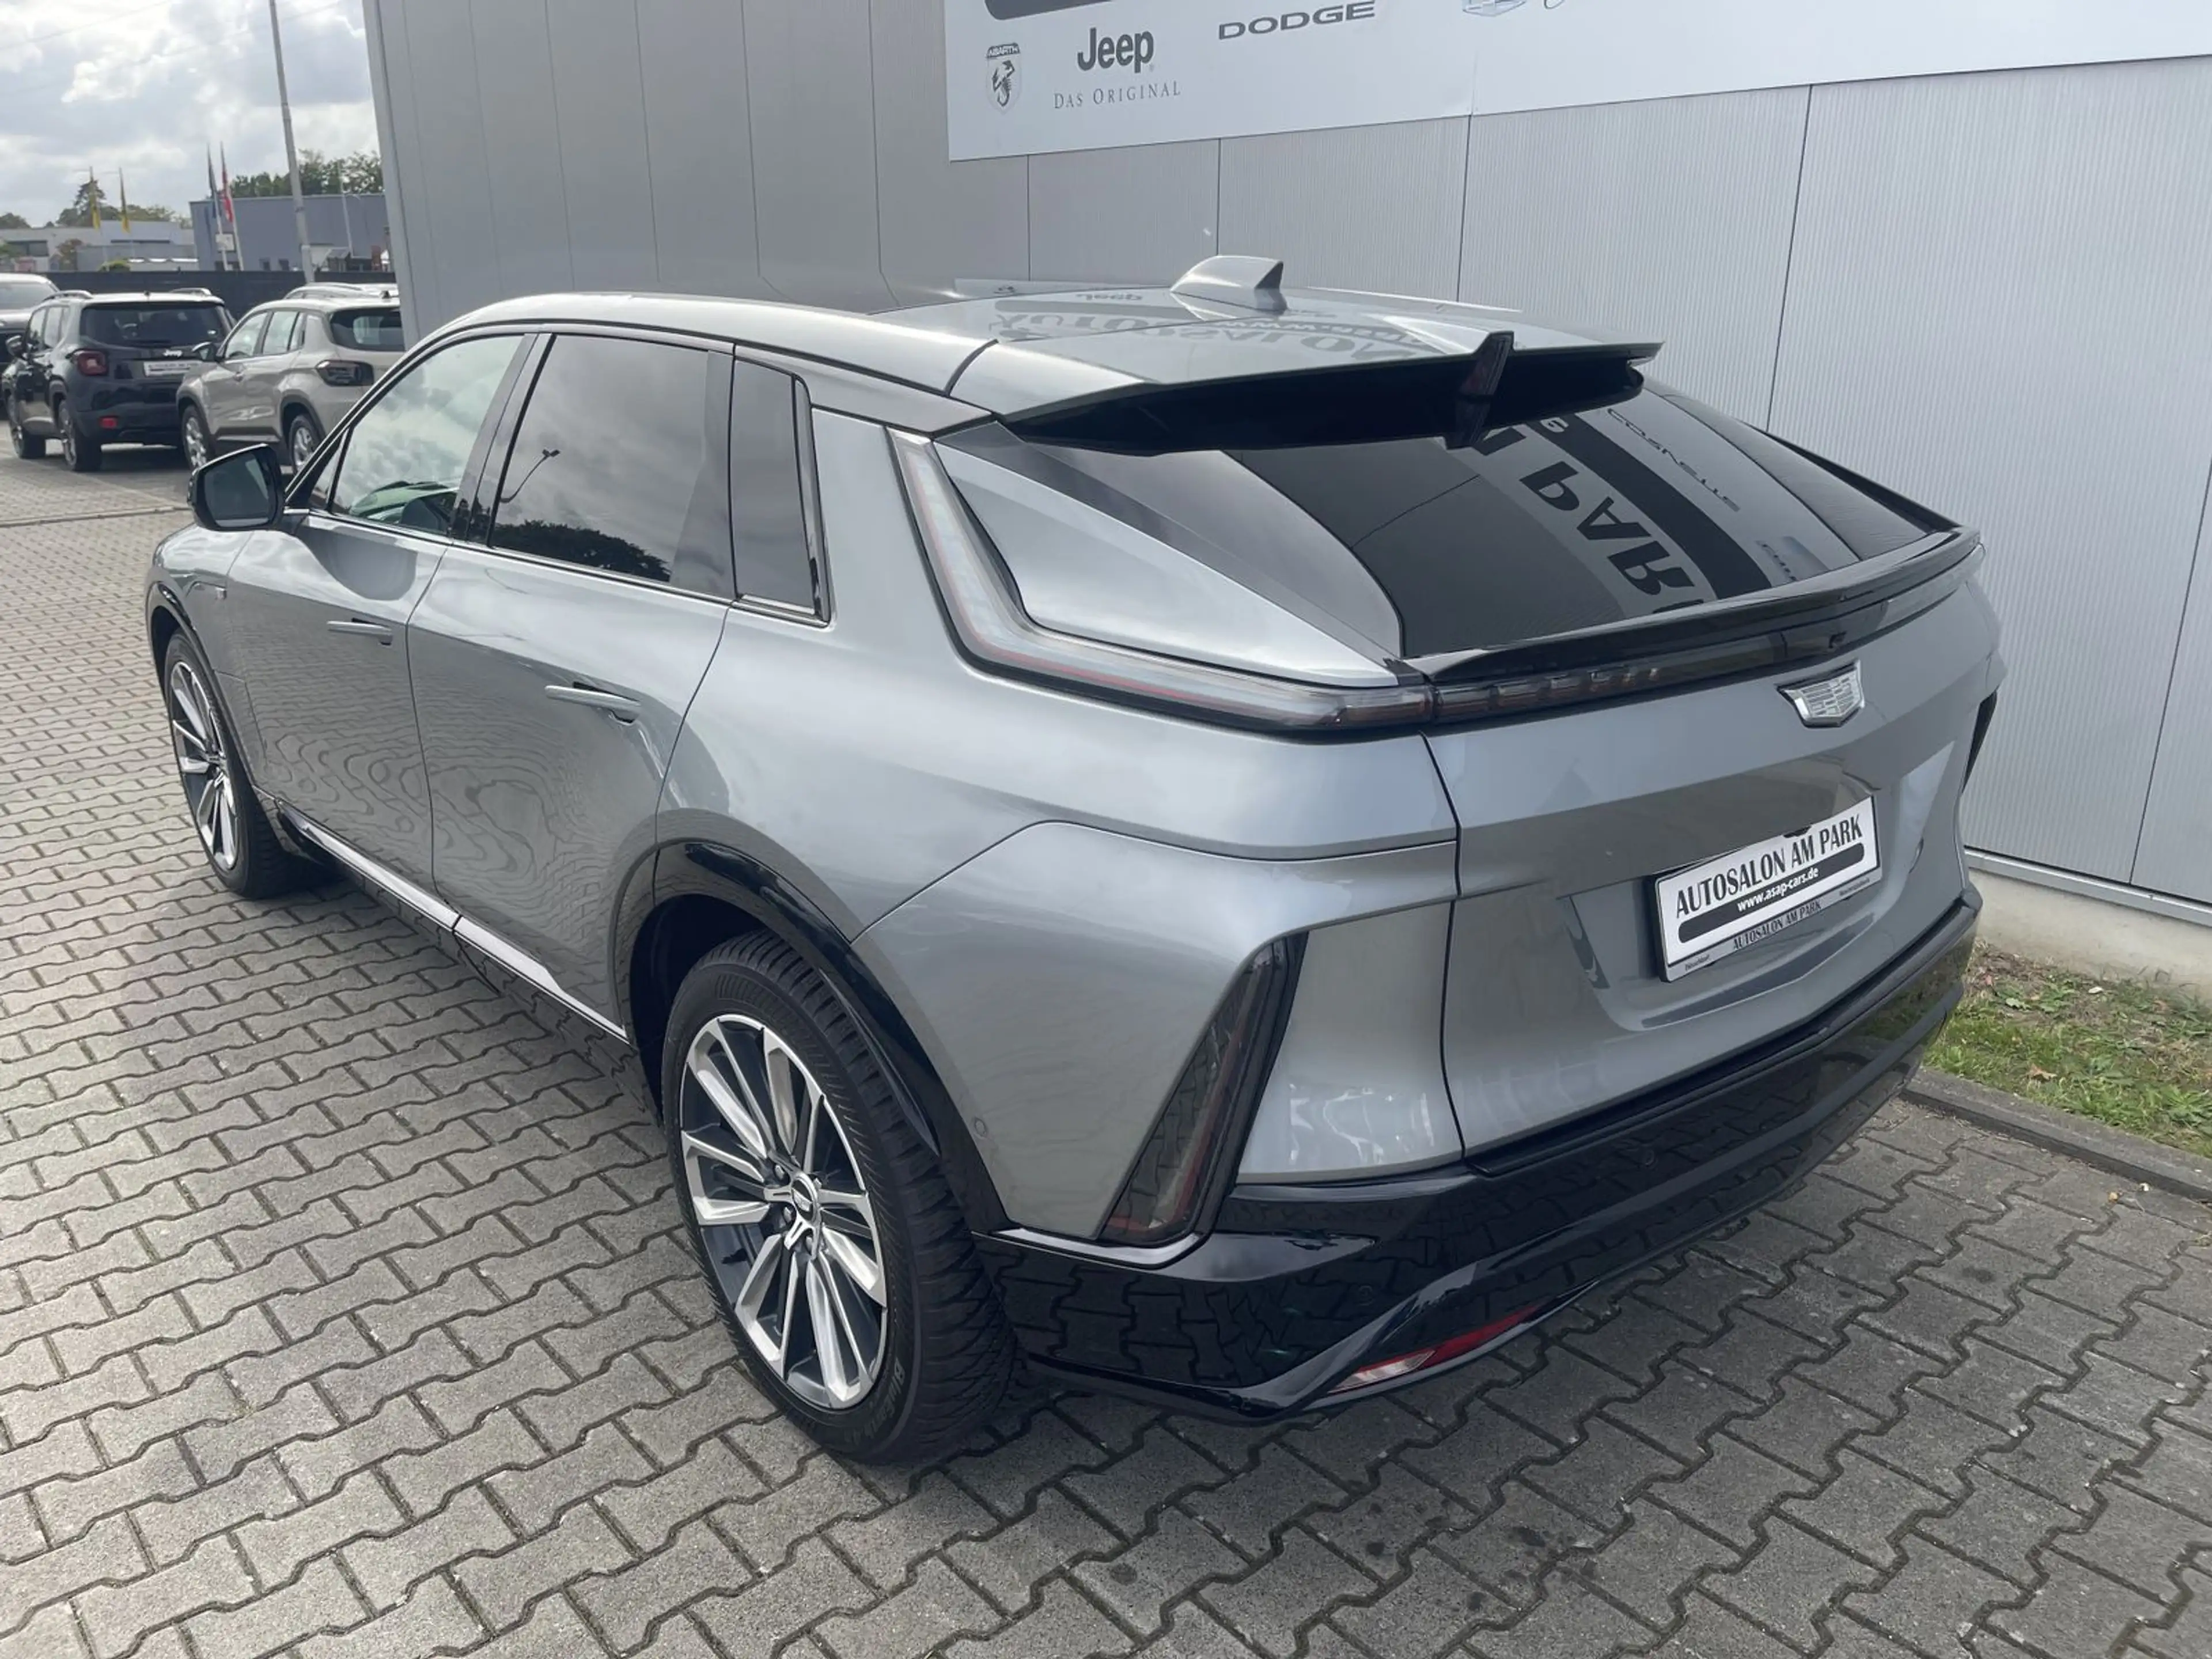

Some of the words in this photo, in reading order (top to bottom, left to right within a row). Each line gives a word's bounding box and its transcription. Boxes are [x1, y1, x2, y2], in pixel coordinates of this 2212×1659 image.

[1219, 1, 1376, 40] DODGE
[1077, 28, 1154, 73] Jeep
[1054, 93, 1083, 109] DAS
[1093, 81, 1181, 104] ORIGINAL
[1676, 847, 1786, 918] AUTOSALON
[1791, 834, 1815, 869] AM
[1820, 813, 1863, 853] PARK
[1737, 866, 1819, 913] www.asap-cars.de
[1733, 920, 1783, 950] AUTOSALON
